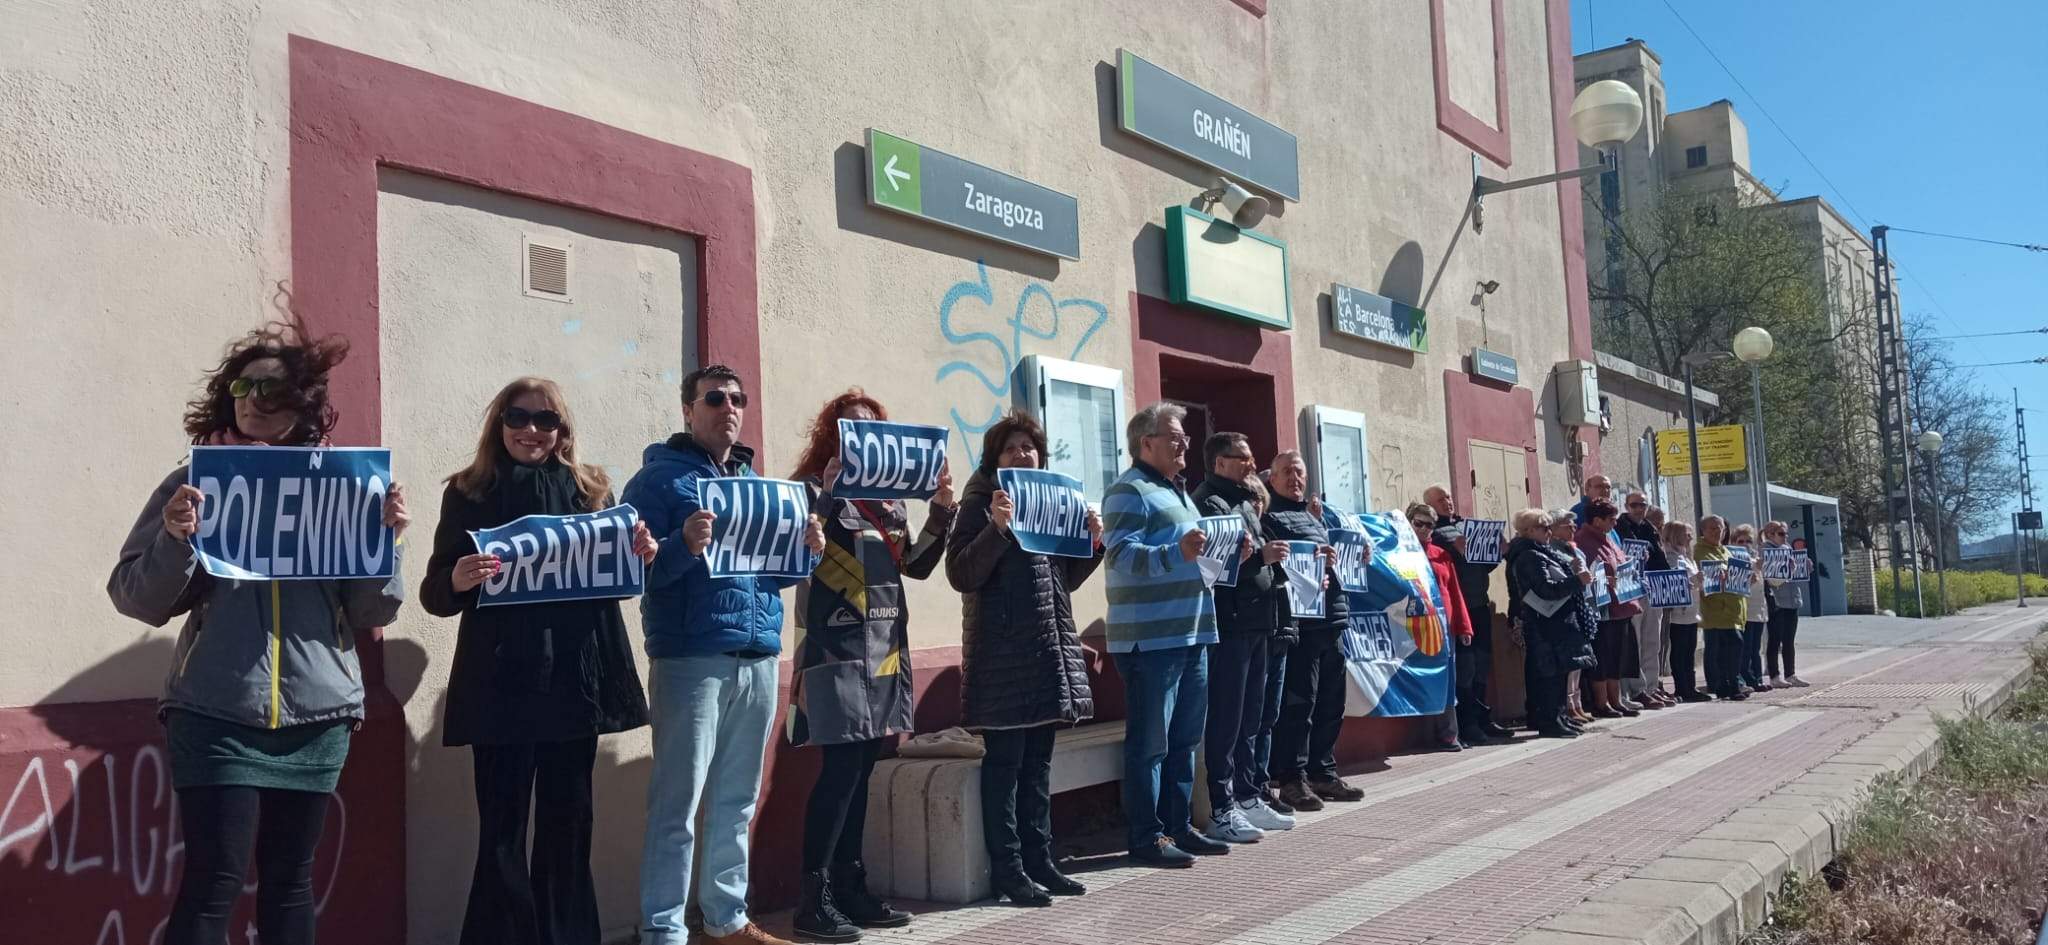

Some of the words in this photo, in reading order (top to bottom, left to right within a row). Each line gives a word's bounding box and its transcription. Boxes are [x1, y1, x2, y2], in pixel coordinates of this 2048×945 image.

[1193, 108, 1252, 161] GRAÑÉN
[964, 181, 1044, 231] Zaragoza
[1355, 304, 1395, 331] Barcelona
[843, 431, 946, 491] SODETO
[704, 482, 808, 572] CALLEN
